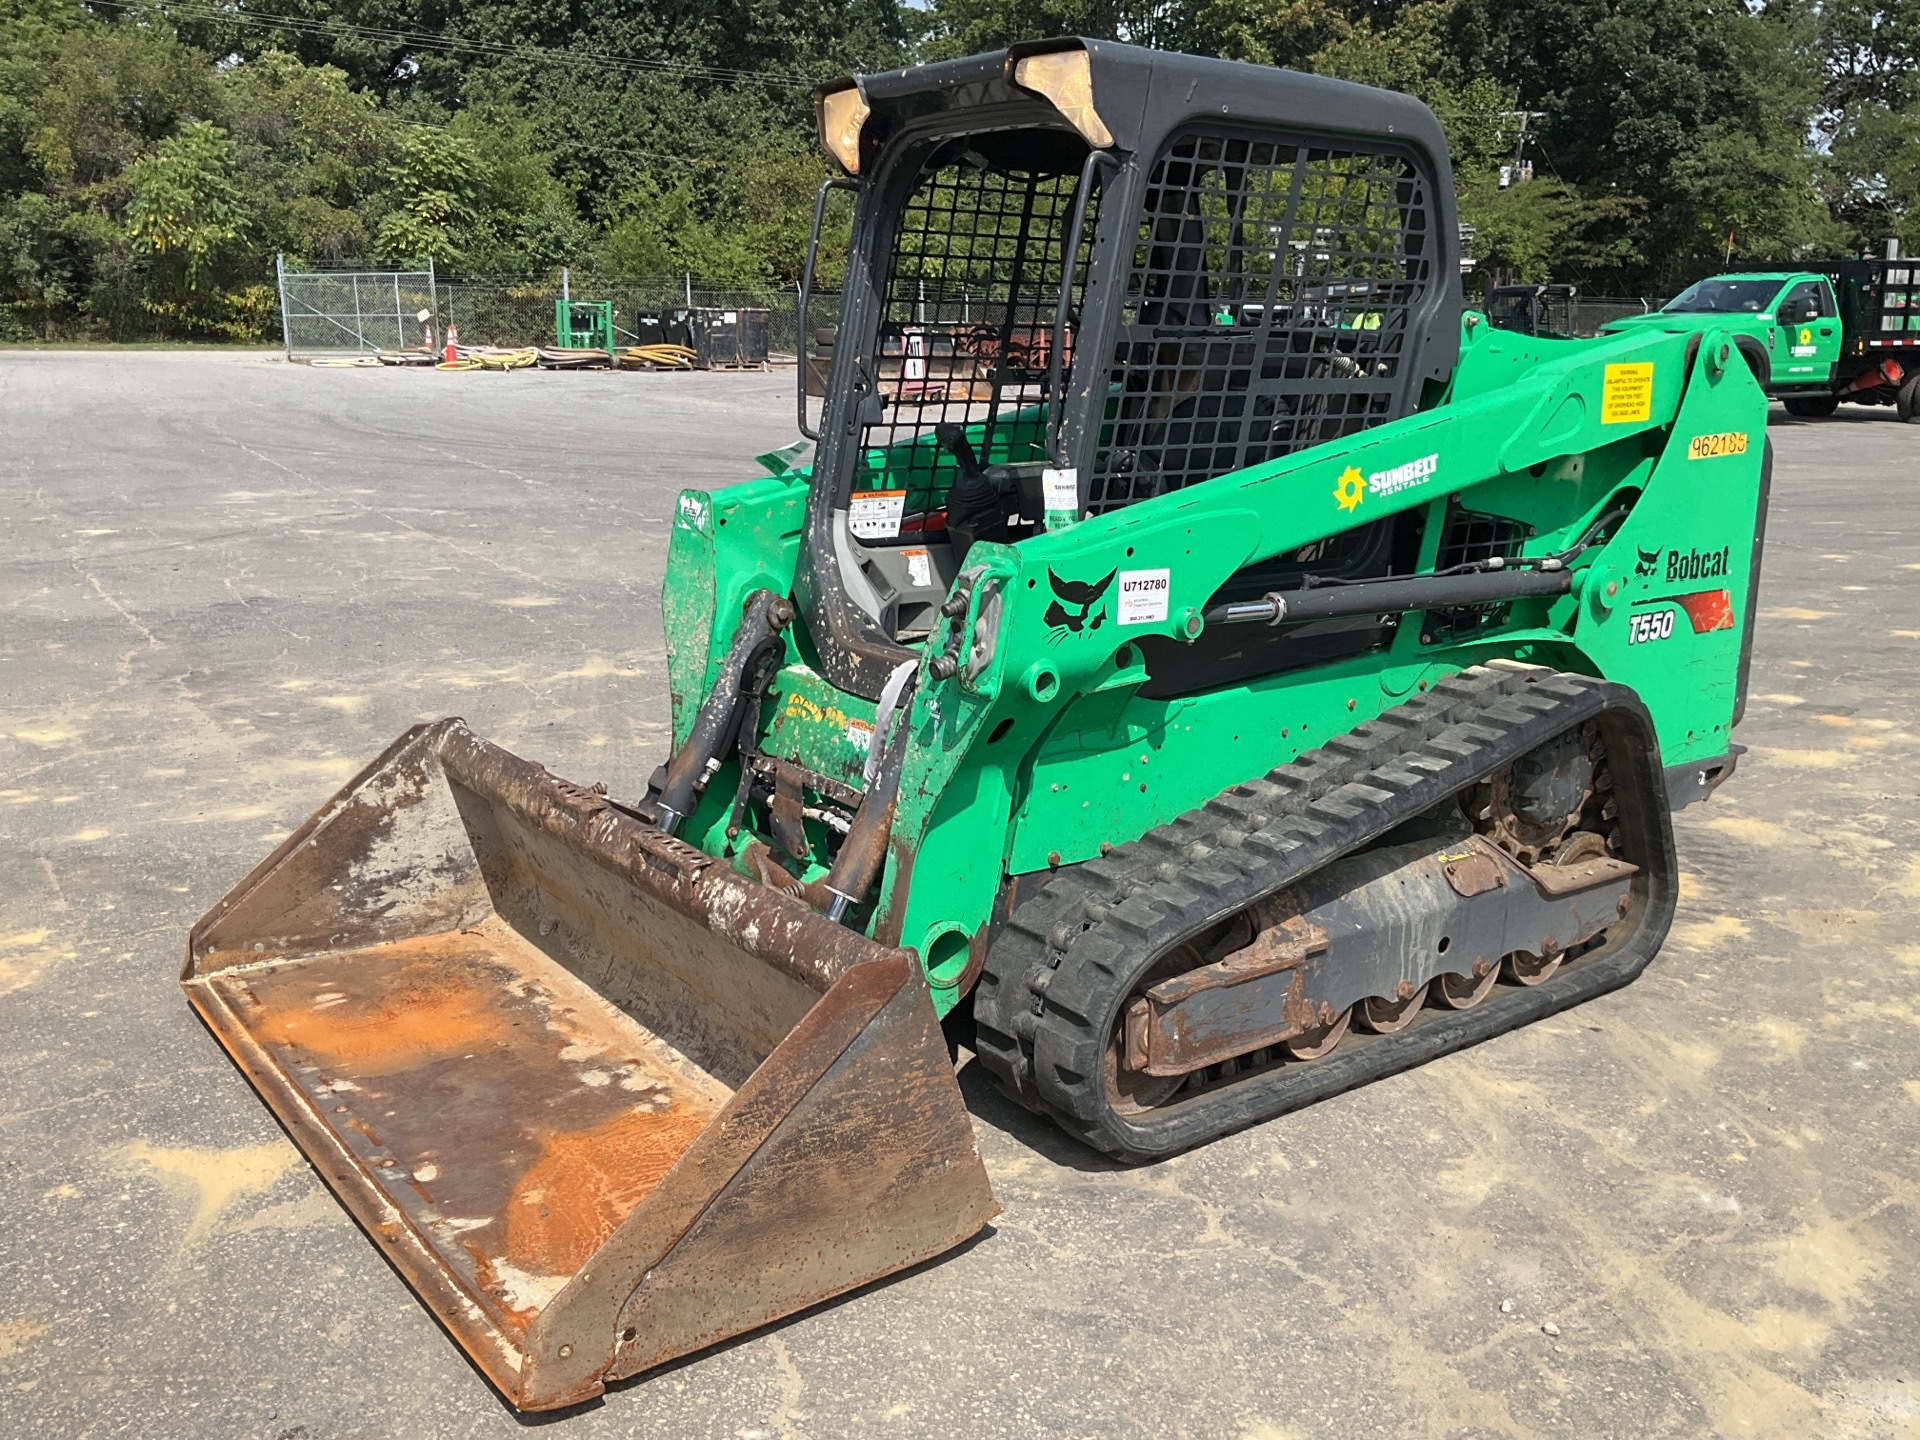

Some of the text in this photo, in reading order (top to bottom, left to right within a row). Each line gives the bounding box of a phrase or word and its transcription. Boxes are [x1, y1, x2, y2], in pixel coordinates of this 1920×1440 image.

[1692, 432, 1746, 457] 962185
[1369, 453, 1439, 493] SUNBELT
[1379, 475, 1430, 498] RENTALS
[1665, 545, 1729, 583] Bobcat
[1124, 579, 1167, 592] U712780
[1628, 609, 1675, 646] T550
